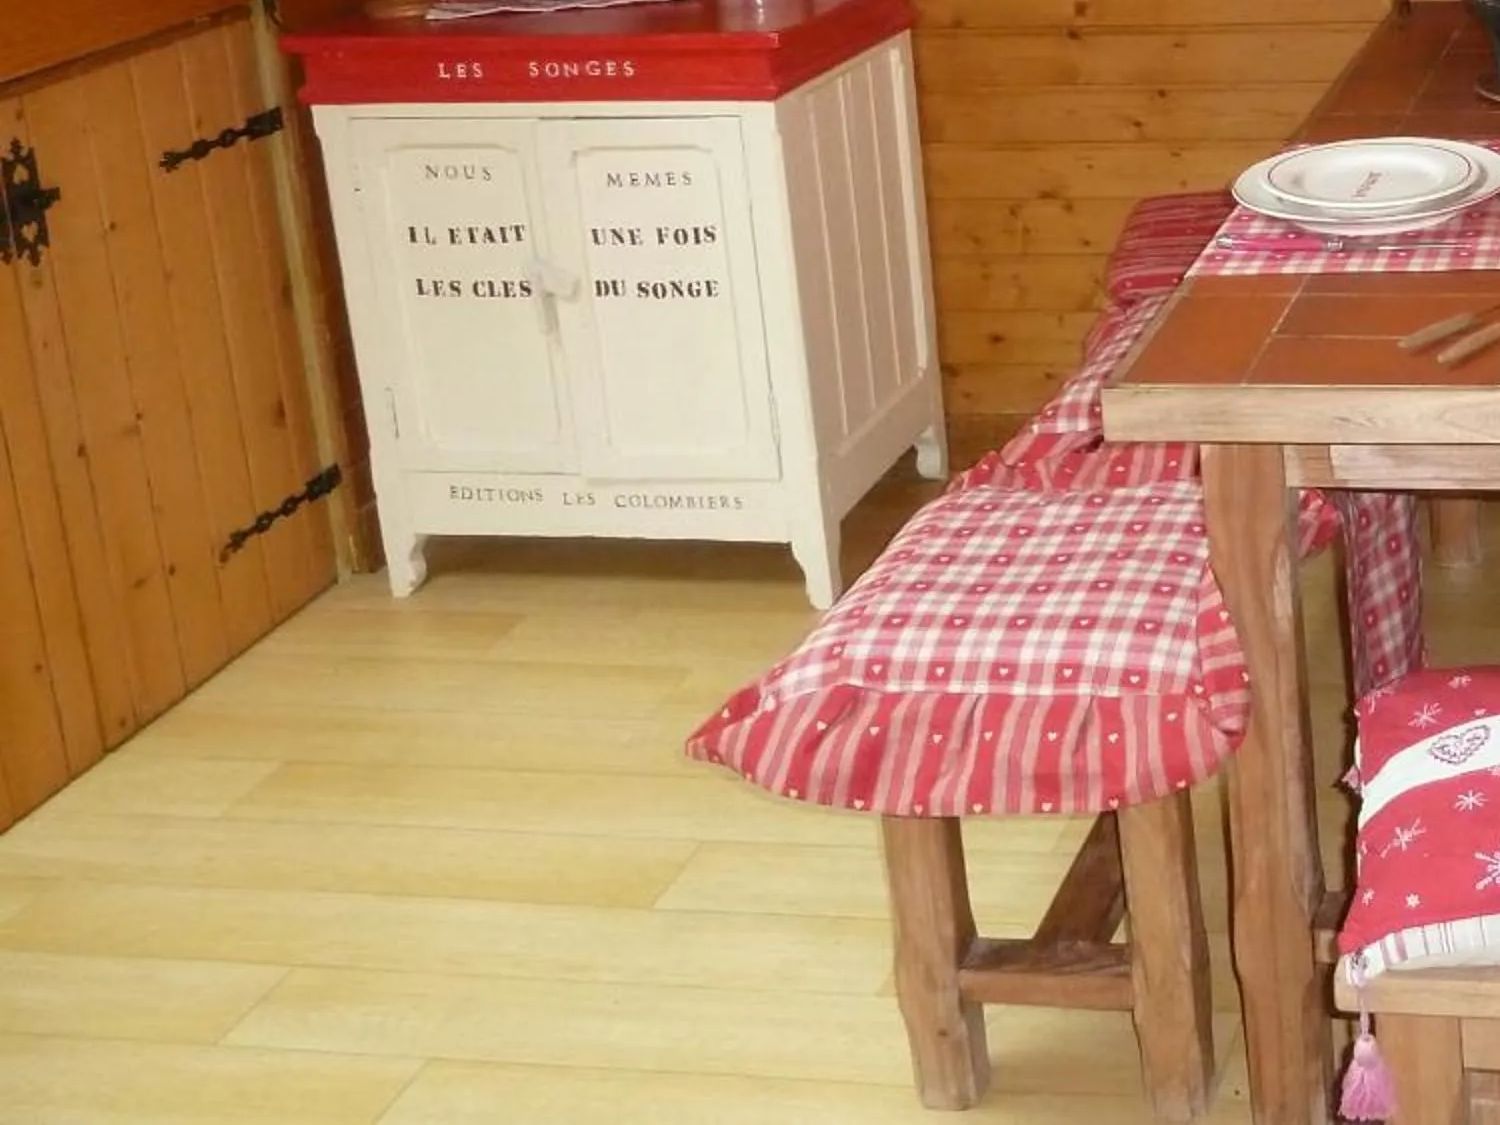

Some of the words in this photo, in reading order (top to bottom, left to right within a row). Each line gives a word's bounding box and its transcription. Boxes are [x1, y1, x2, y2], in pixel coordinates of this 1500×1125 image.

[437, 61, 483, 79] LES
[528, 59, 635, 78] SONGES
[425, 164, 492, 181] NOUS
[606, 172, 693, 187] MEMES
[407, 226, 437, 245] IL
[448, 225, 525, 246] ETAIT
[591, 227, 643, 246] UNE
[655, 225, 717, 246] FOIS
[415, 278, 462, 298] LES
[472, 279, 533, 299] CLES
[594, 279, 626, 298] DU
[637, 279, 720, 300] SONGE
[450, 485, 544, 503] EDITIONS
[562, 491, 596, 507] LES
[614, 493, 744, 511] COLOMBIERS
